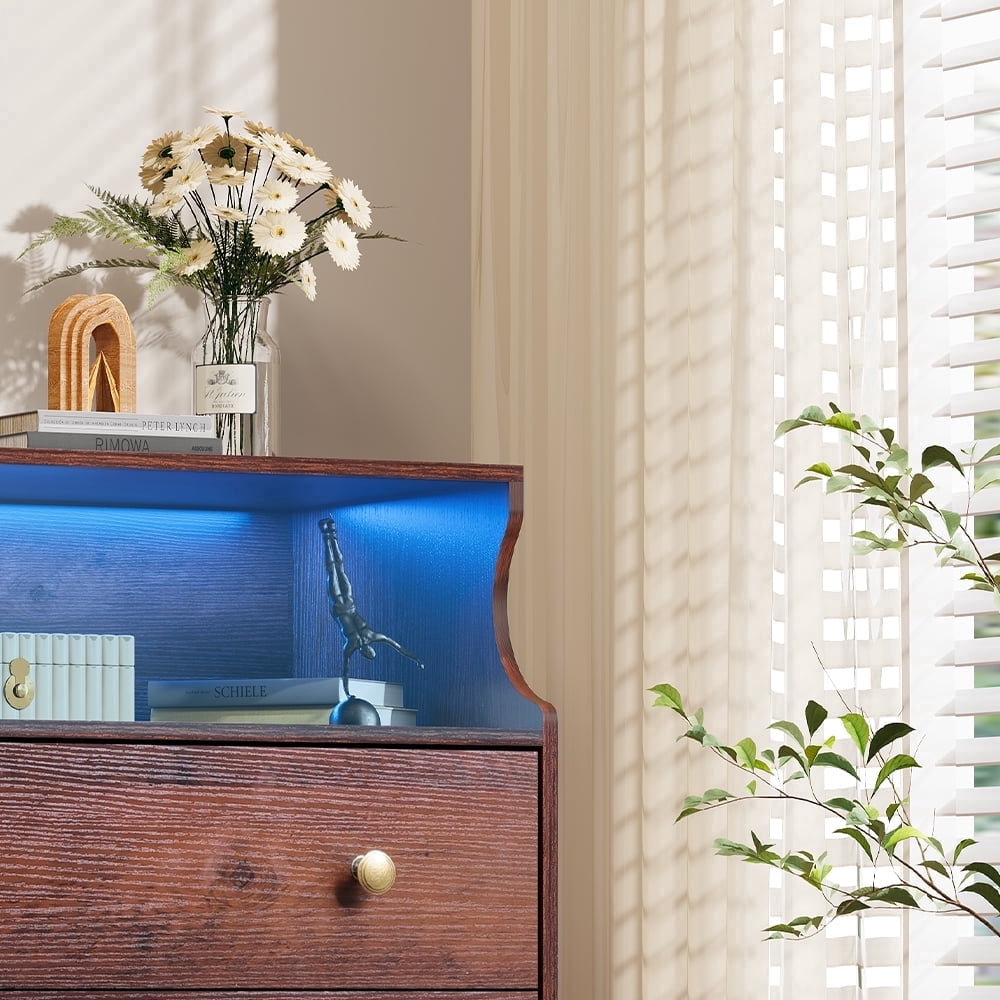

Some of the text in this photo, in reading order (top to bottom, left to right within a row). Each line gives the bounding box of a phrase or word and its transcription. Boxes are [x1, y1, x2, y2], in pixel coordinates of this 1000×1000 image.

[142, 420, 173, 431] PETER
[175, 422, 206, 433] LYNCH
[95, 437, 150, 452] RIMOWA
[214, 685, 268, 698] SCHIELE
